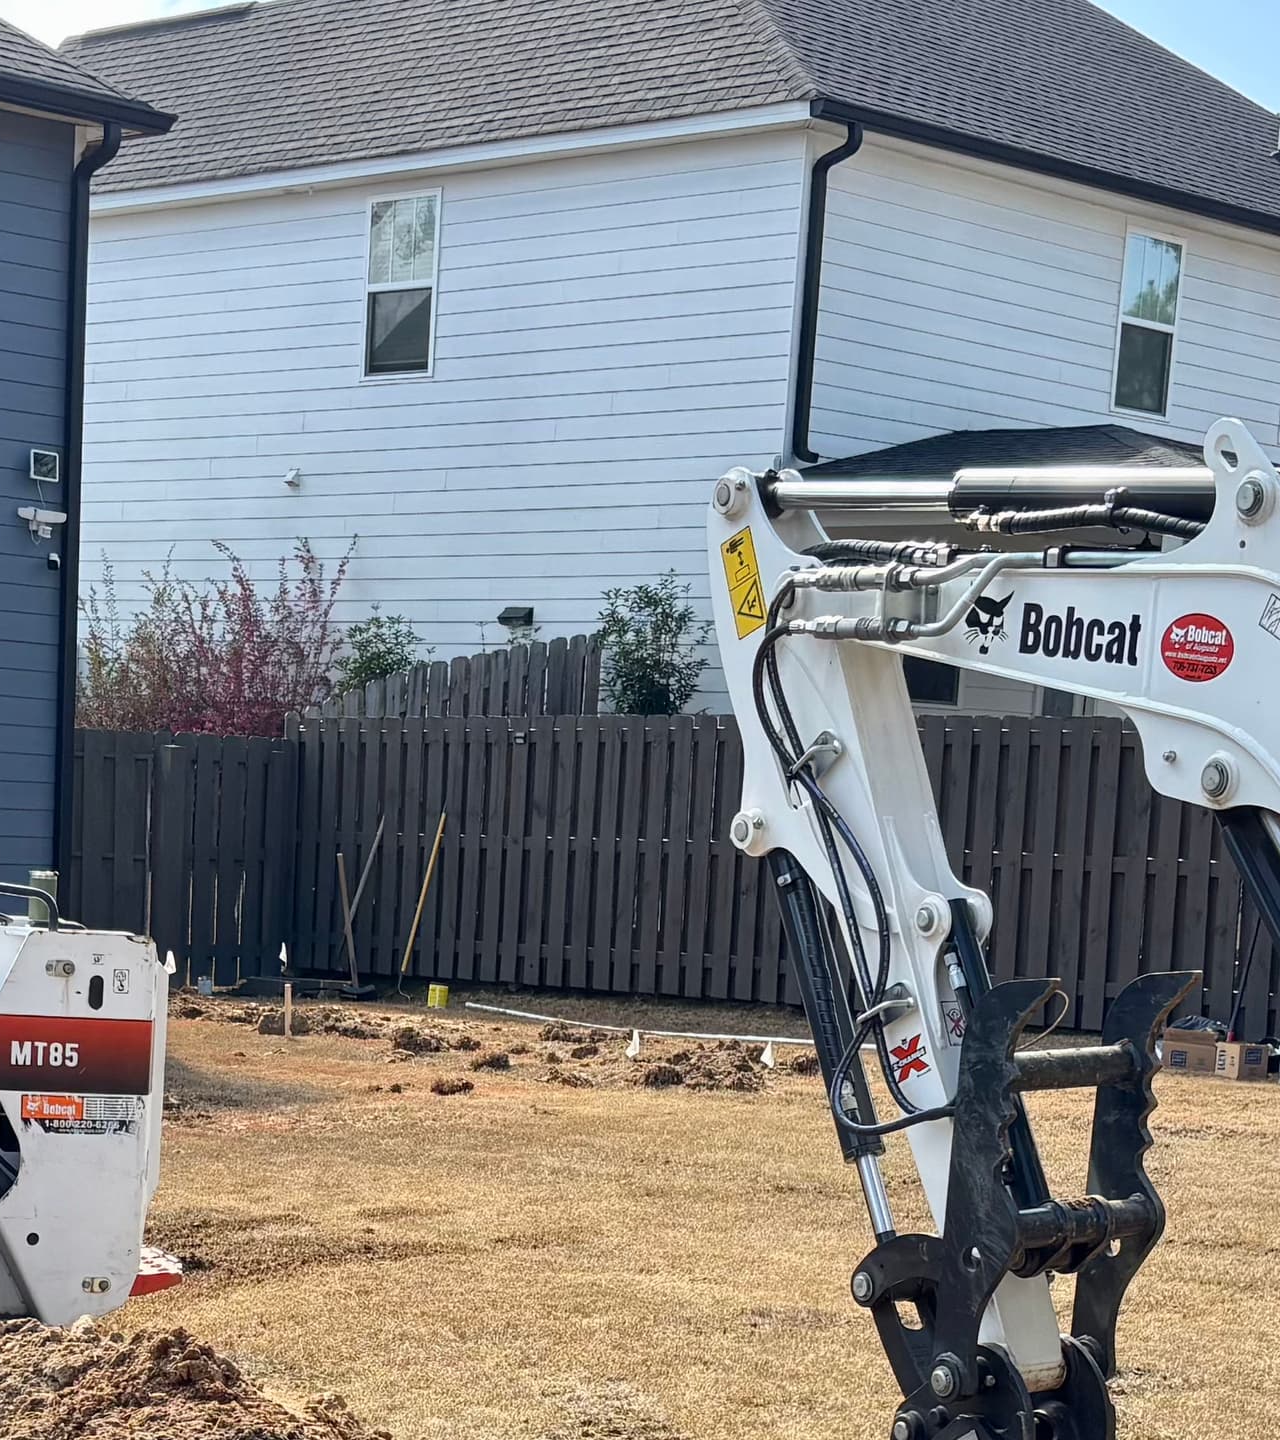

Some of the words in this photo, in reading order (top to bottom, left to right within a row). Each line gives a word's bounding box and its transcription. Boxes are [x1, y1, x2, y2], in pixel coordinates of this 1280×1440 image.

[1019, 602, 1142, 667] Bobcat
[1187, 624, 1227, 646] Bobcat
[10, 1040, 79, 1067] MT85
[42, 1102, 76, 1117] Bobcat
